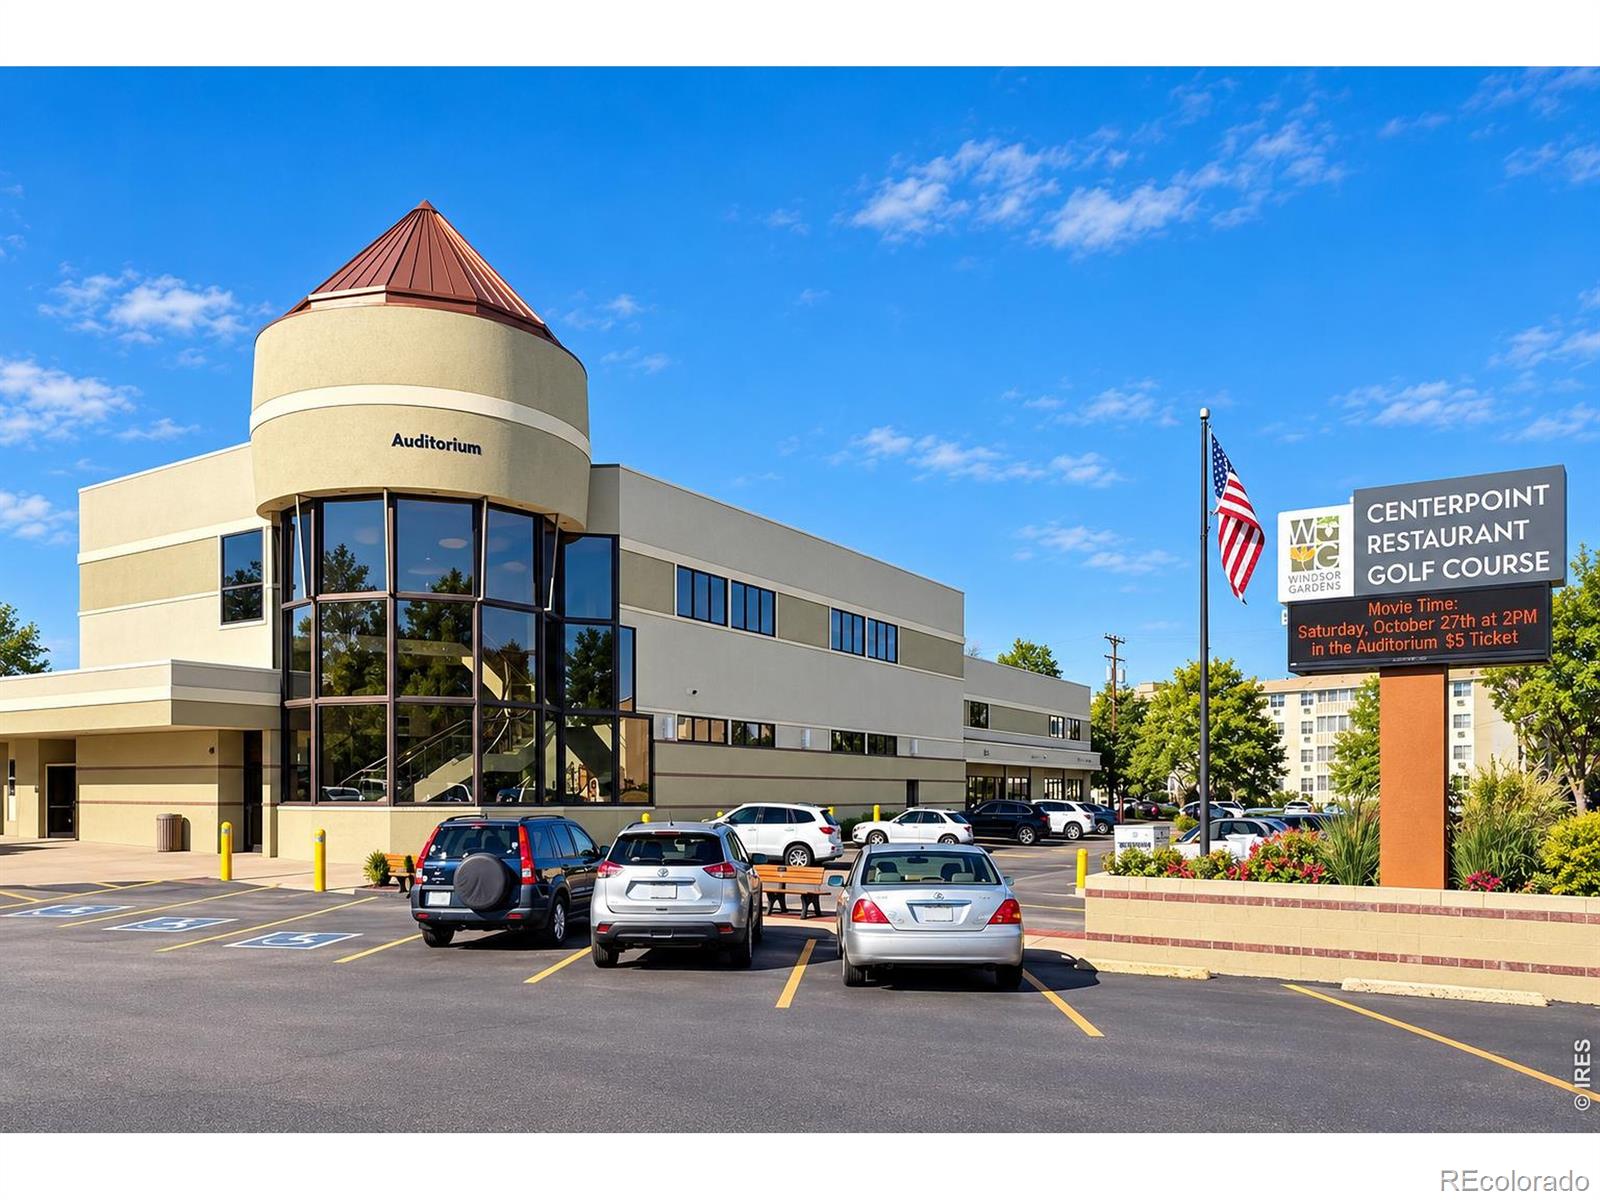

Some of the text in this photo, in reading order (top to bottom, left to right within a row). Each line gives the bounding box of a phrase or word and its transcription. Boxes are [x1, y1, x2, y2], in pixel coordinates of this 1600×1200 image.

[391, 433, 482, 456] Auditorium
[1366, 484, 1550, 524] CENTERPOINT
[1367, 519, 1530, 555] RESTAURANT
[1288, 571, 1341, 584] WINDSOR
[1367, 551, 1550, 585] GOLF COURSE
[1288, 581, 1341, 594] GARDENS
[1368, 598, 1458, 616] Movie Time:
[1298, 608, 1537, 639] Saturday, October 27th at 2PM
[1311, 630, 1519, 656] in the Auditorium $5 Ticket
